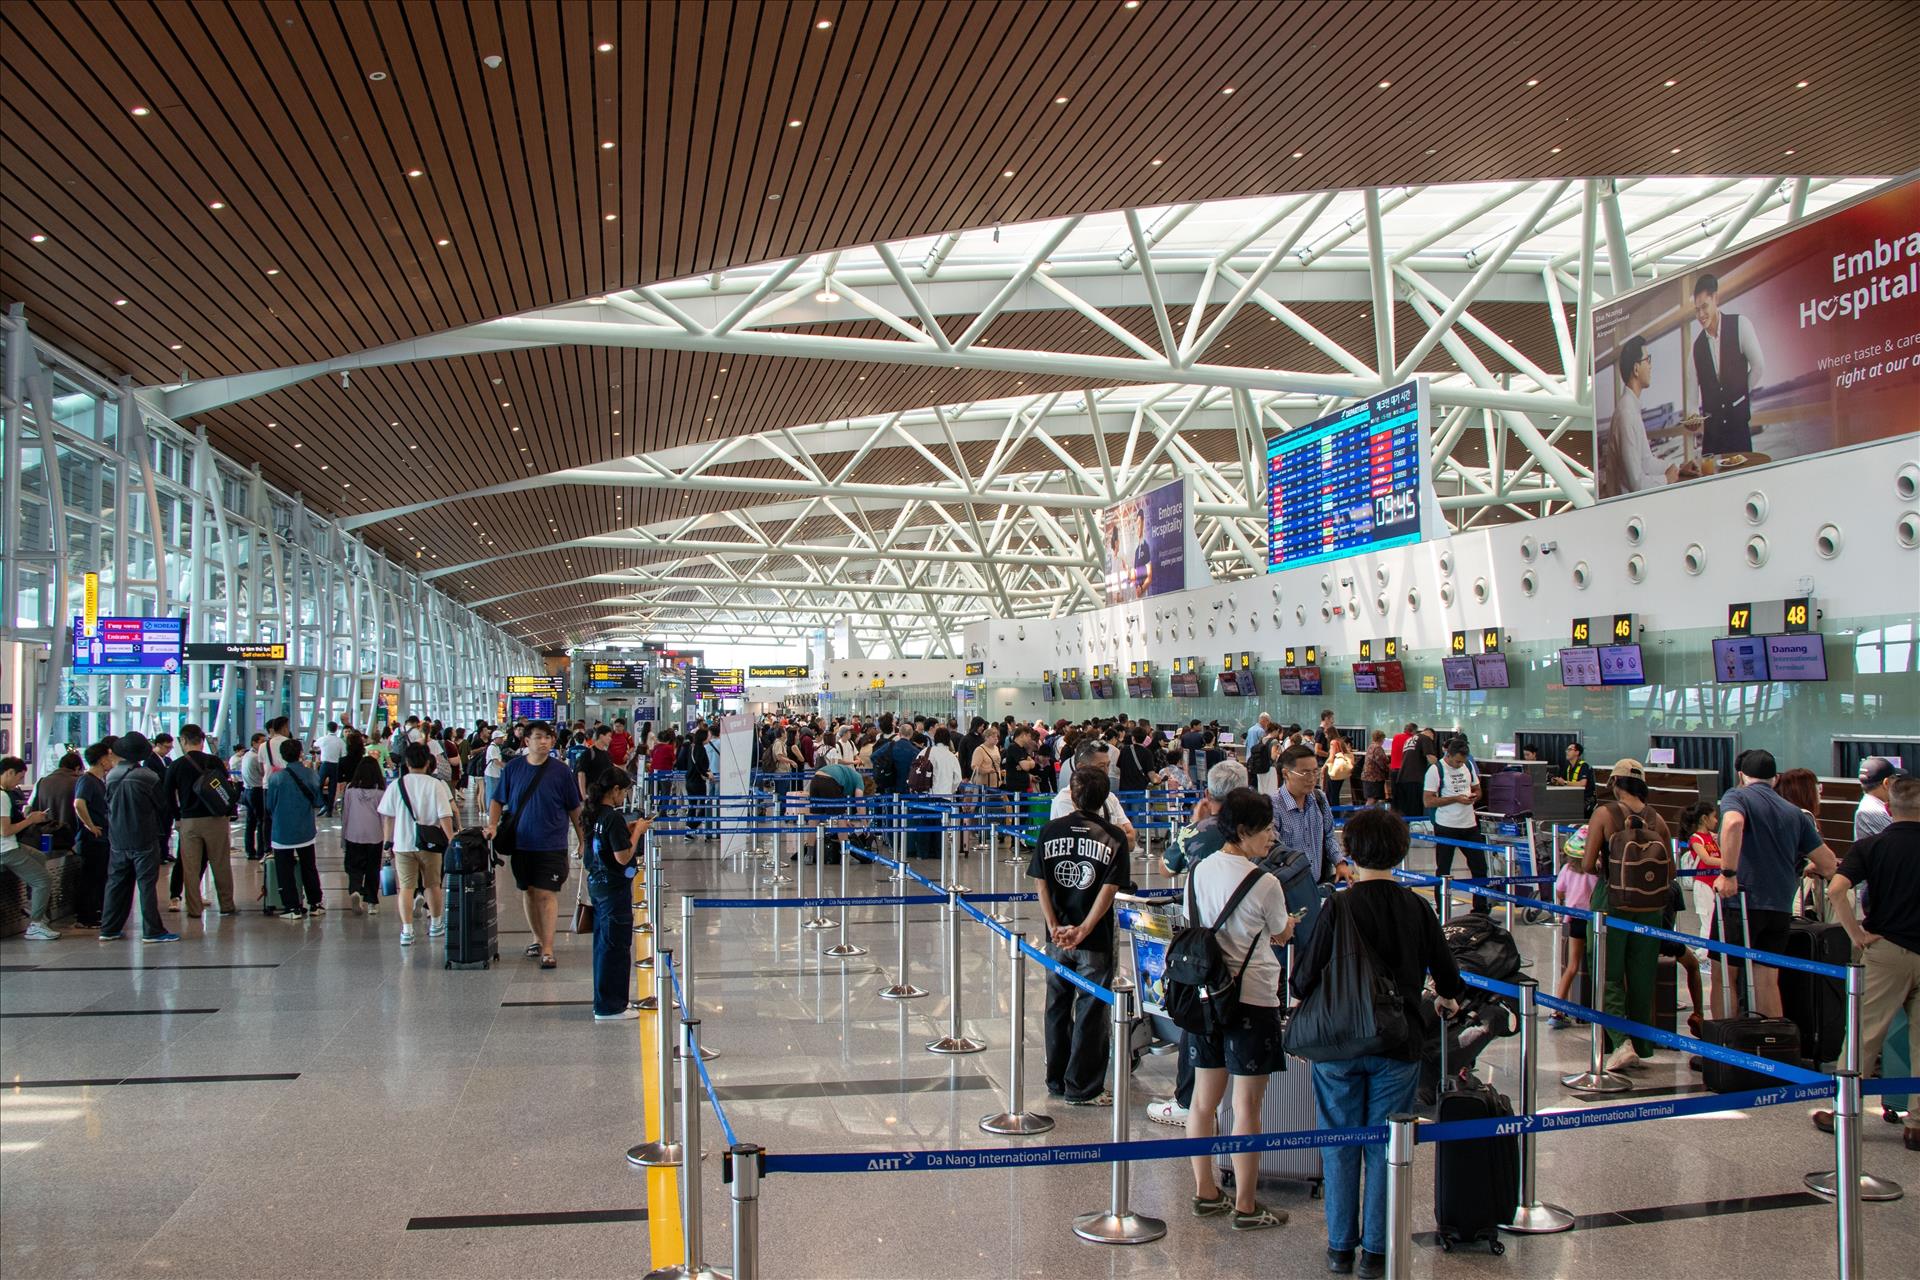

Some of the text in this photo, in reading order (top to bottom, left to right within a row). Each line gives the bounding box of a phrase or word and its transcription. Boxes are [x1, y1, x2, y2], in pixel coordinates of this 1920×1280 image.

[1833, 232, 1920, 283] Embra
[1800, 262, 1920, 329] Hospital
[1596, 308, 1623, 323] Da Nang
[1597, 314, 1630, 330] International
[1597, 326, 1616, 338] Airport
[1817, 353, 1851, 371] Where
[1854, 345, 1881, 361] taste
[1885, 339, 1894, 352] &
[1836, 367, 1866, 388] right
[1869, 363, 1882, 378] at
[1886, 356, 1909, 373] our
[1346, 402, 1369, 418] DEPARTURES
[1158, 503, 1182, 520] Embrace
[1376, 490, 1415, 526] 09:45
[1152, 518, 1183, 538] Hospitality
[1731, 610, 1749, 628] 47
[1787, 606, 1806, 625] 48
[1574, 624, 1588, 640] 45
[1616, 620, 1630, 637] 46
[1453, 636, 1465, 650] 43
[1486, 632, 1497, 647] 44
[1361, 644, 1370, 657] 41
[1386, 642, 1395, 655] 42
[1772, 646, 1808, 654] Danang
[1225, 657, 1231, 668] 37
[1286, 651, 1294, 663] 39
[1307, 650, 1315, 662] 40
[751, 668, 785, 676] Departures
[1044, 838, 1112, 865] KEEP GOING
[1634, 926, 1644, 934] AHT
[1243, 1018, 1252, 1030] 2
[1265, 1038, 1272, 1051] 5
[1190, 1046, 1197, 1060] 9
[1246, 1060, 1258, 1072] 4
[1795, 1088, 1806, 1098] Da
[1808, 1087, 1828, 1098] Nang
[1754, 1094, 1778, 1106] AHT
[1543, 1104, 1675, 1128] Da Nang International Terminal
[1496, 1122, 1522, 1134] AHT
[1267, 1132, 1379, 1147] Da Nang International
[1212, 1141, 1240, 1153] AHT
[867, 1159, 901, 1170] AHT
[927, 1148, 1101, 1167] Da Nang International Terminal
